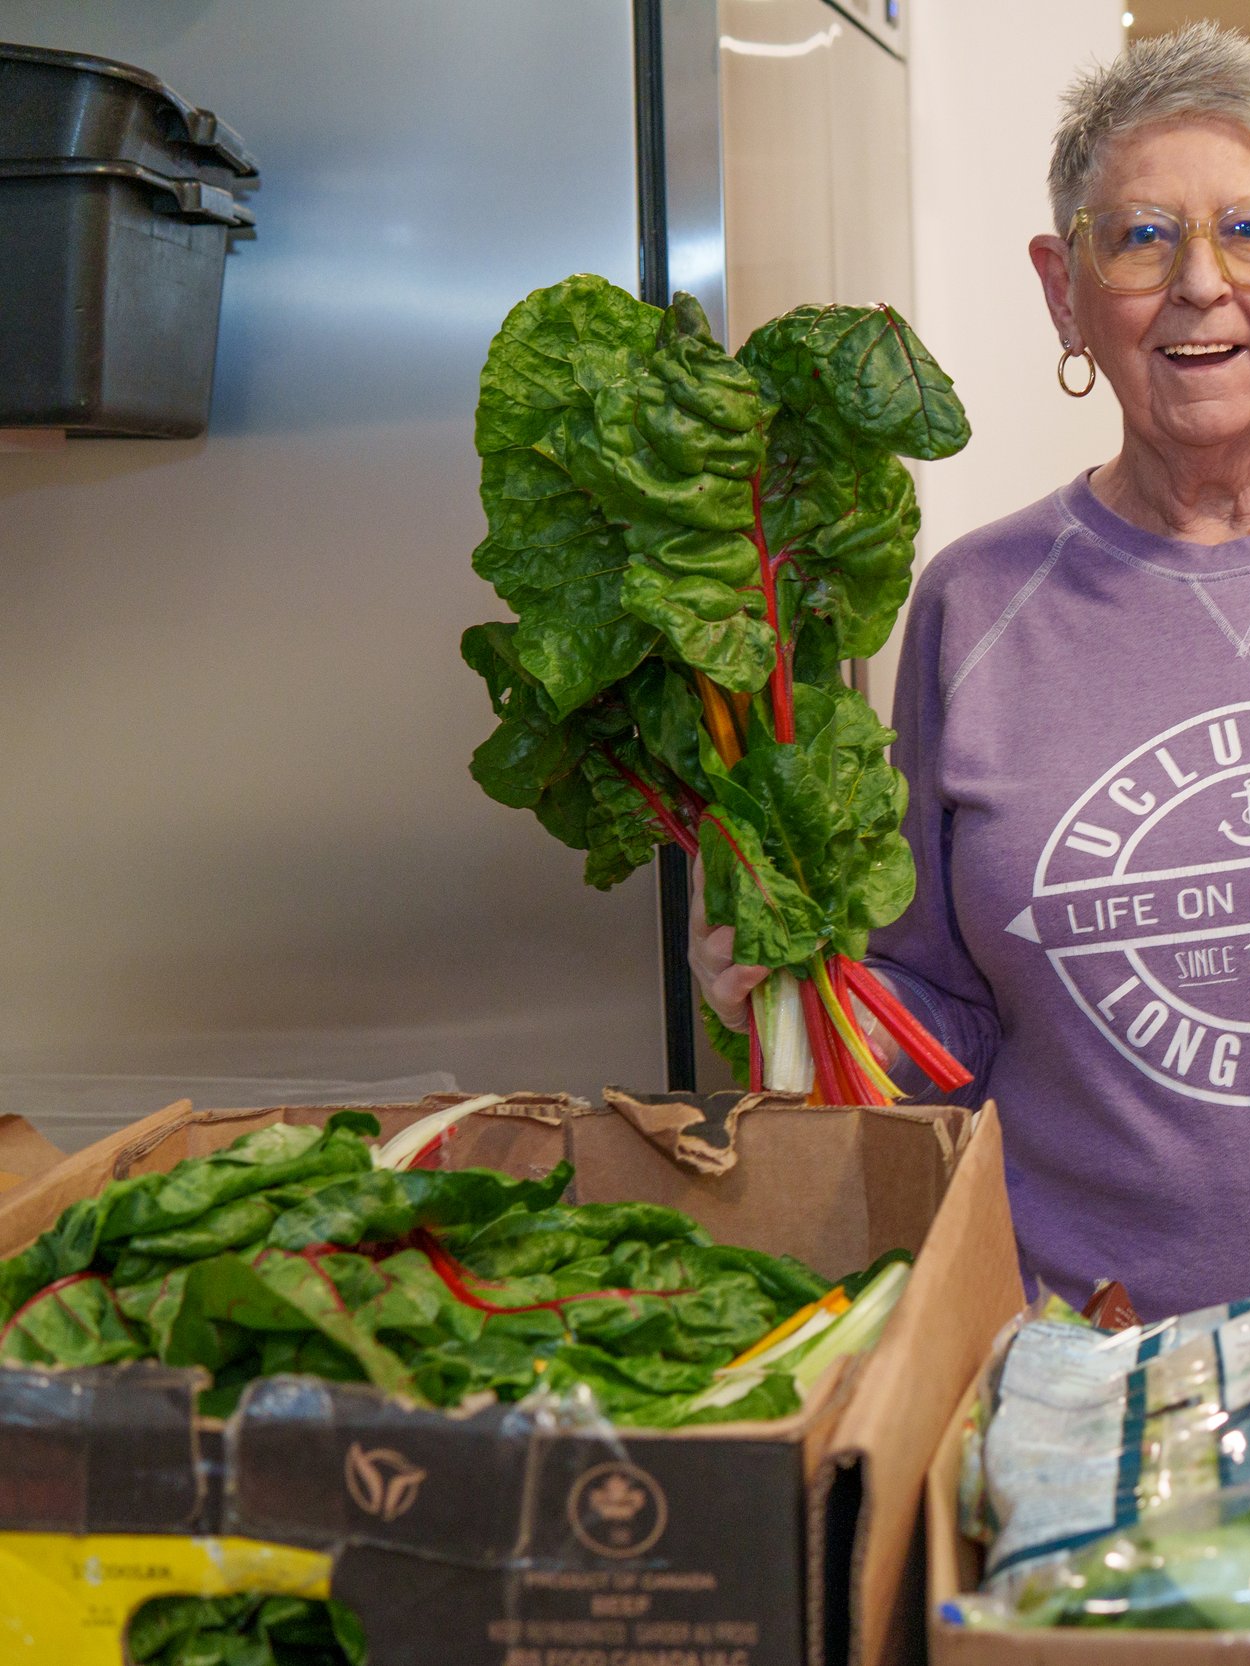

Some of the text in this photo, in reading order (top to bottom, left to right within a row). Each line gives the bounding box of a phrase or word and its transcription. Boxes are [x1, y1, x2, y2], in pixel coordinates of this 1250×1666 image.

[1066, 893, 1159, 935] LIFE
[1177, 882, 1235, 919] ON
[1174, 945, 1238, 979] SINCE
[1096, 975, 1240, 1088] LONG
